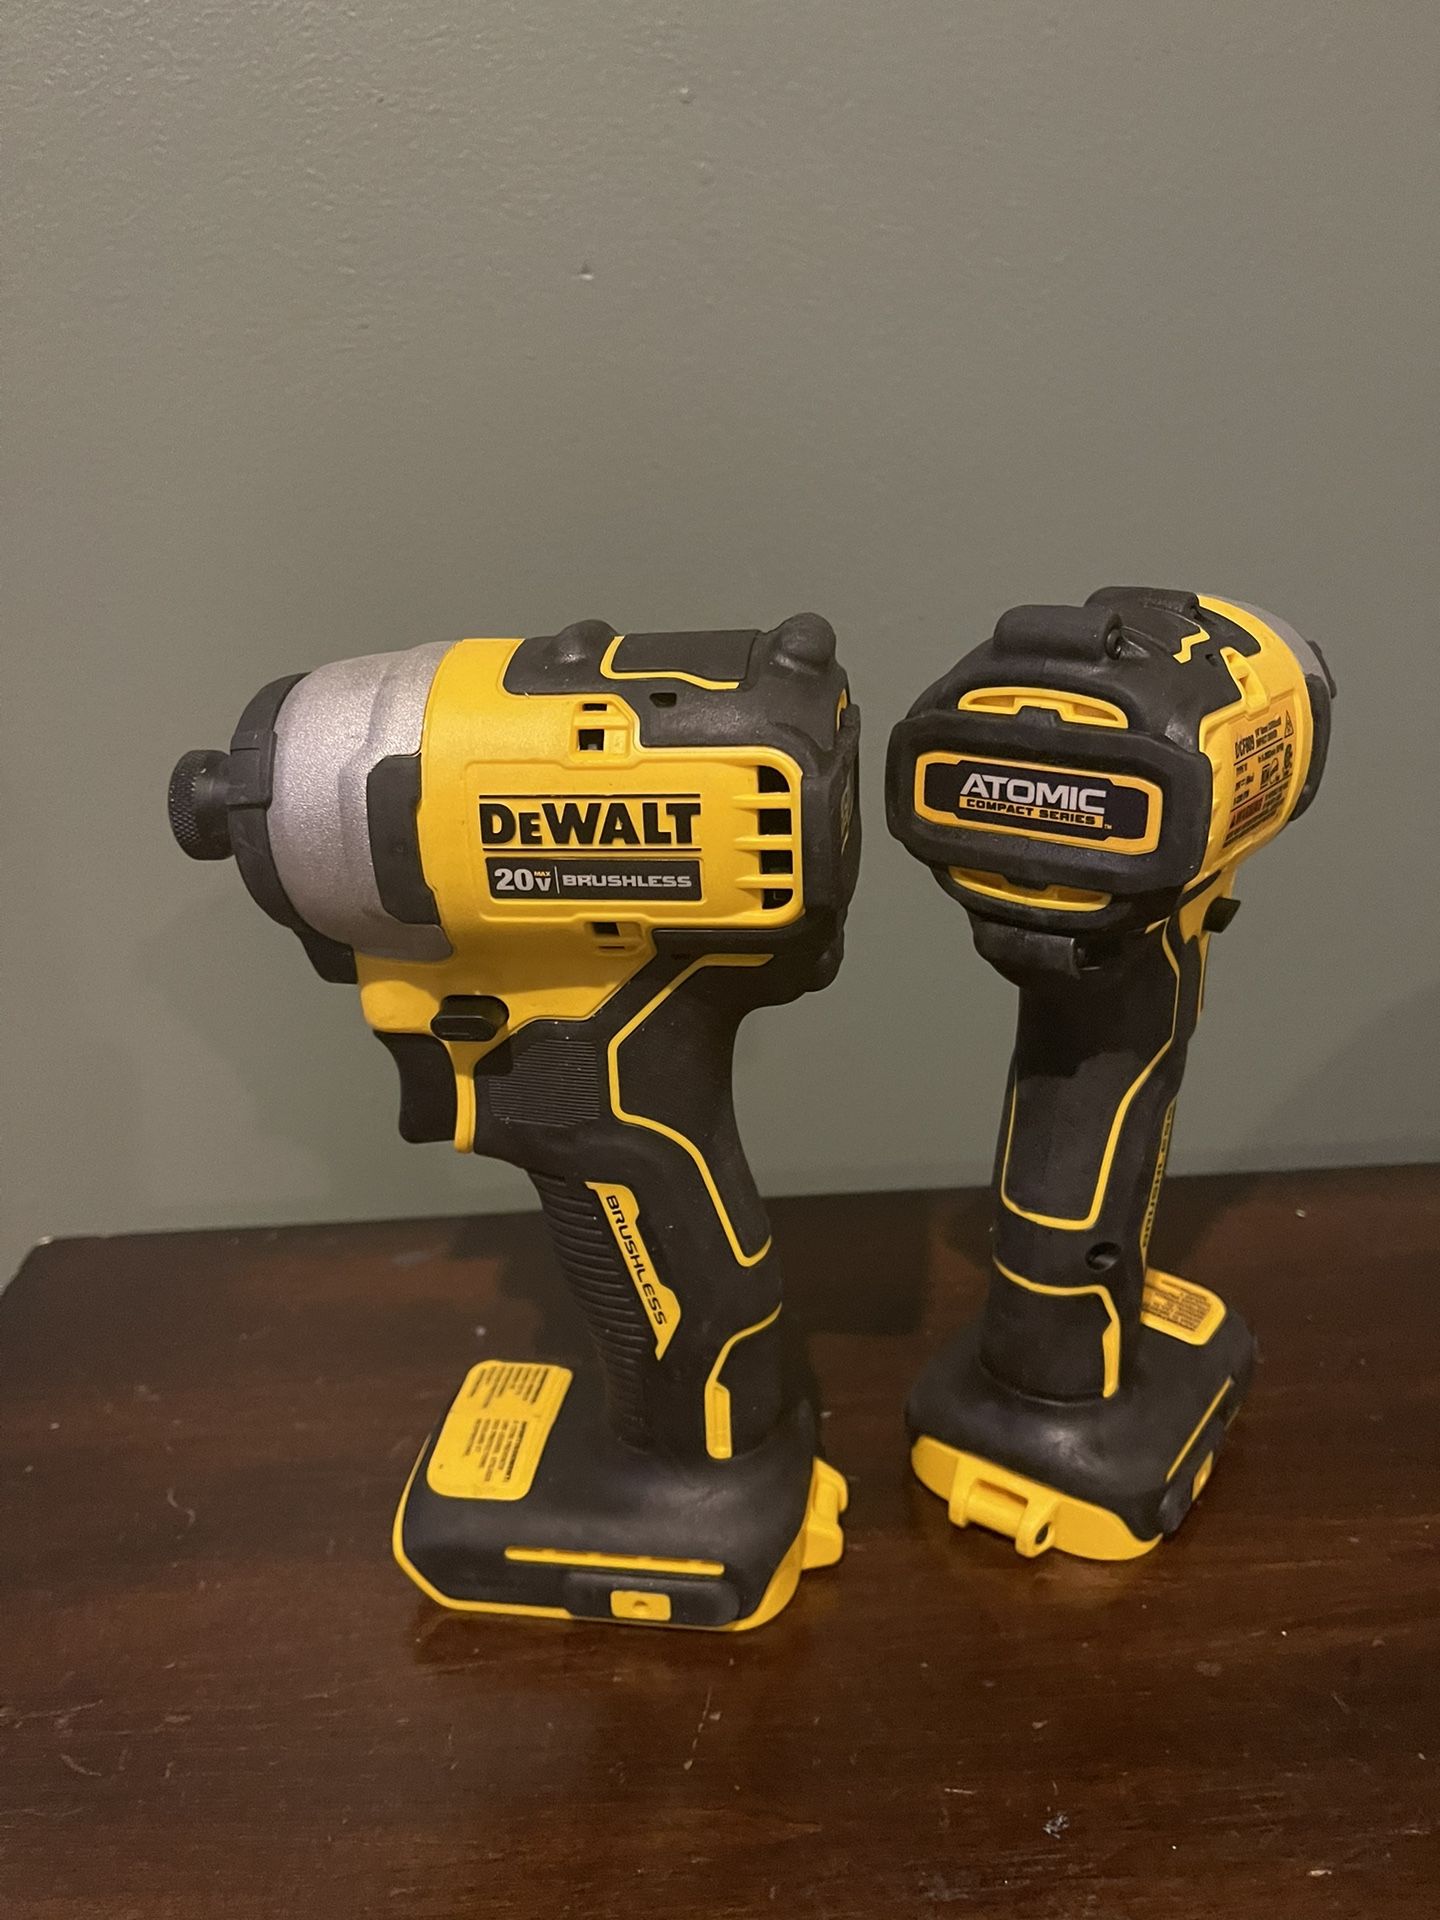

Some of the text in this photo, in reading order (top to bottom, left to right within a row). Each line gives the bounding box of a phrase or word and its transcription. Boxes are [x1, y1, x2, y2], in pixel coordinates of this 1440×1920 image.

[960, 773, 1107, 814] ATOMIC
[966, 798, 1096, 825] COMPACT SERIES
[562, 874, 692, 888] BRUSHLESS
[606, 1194, 668, 1326] BRUSHLESS
